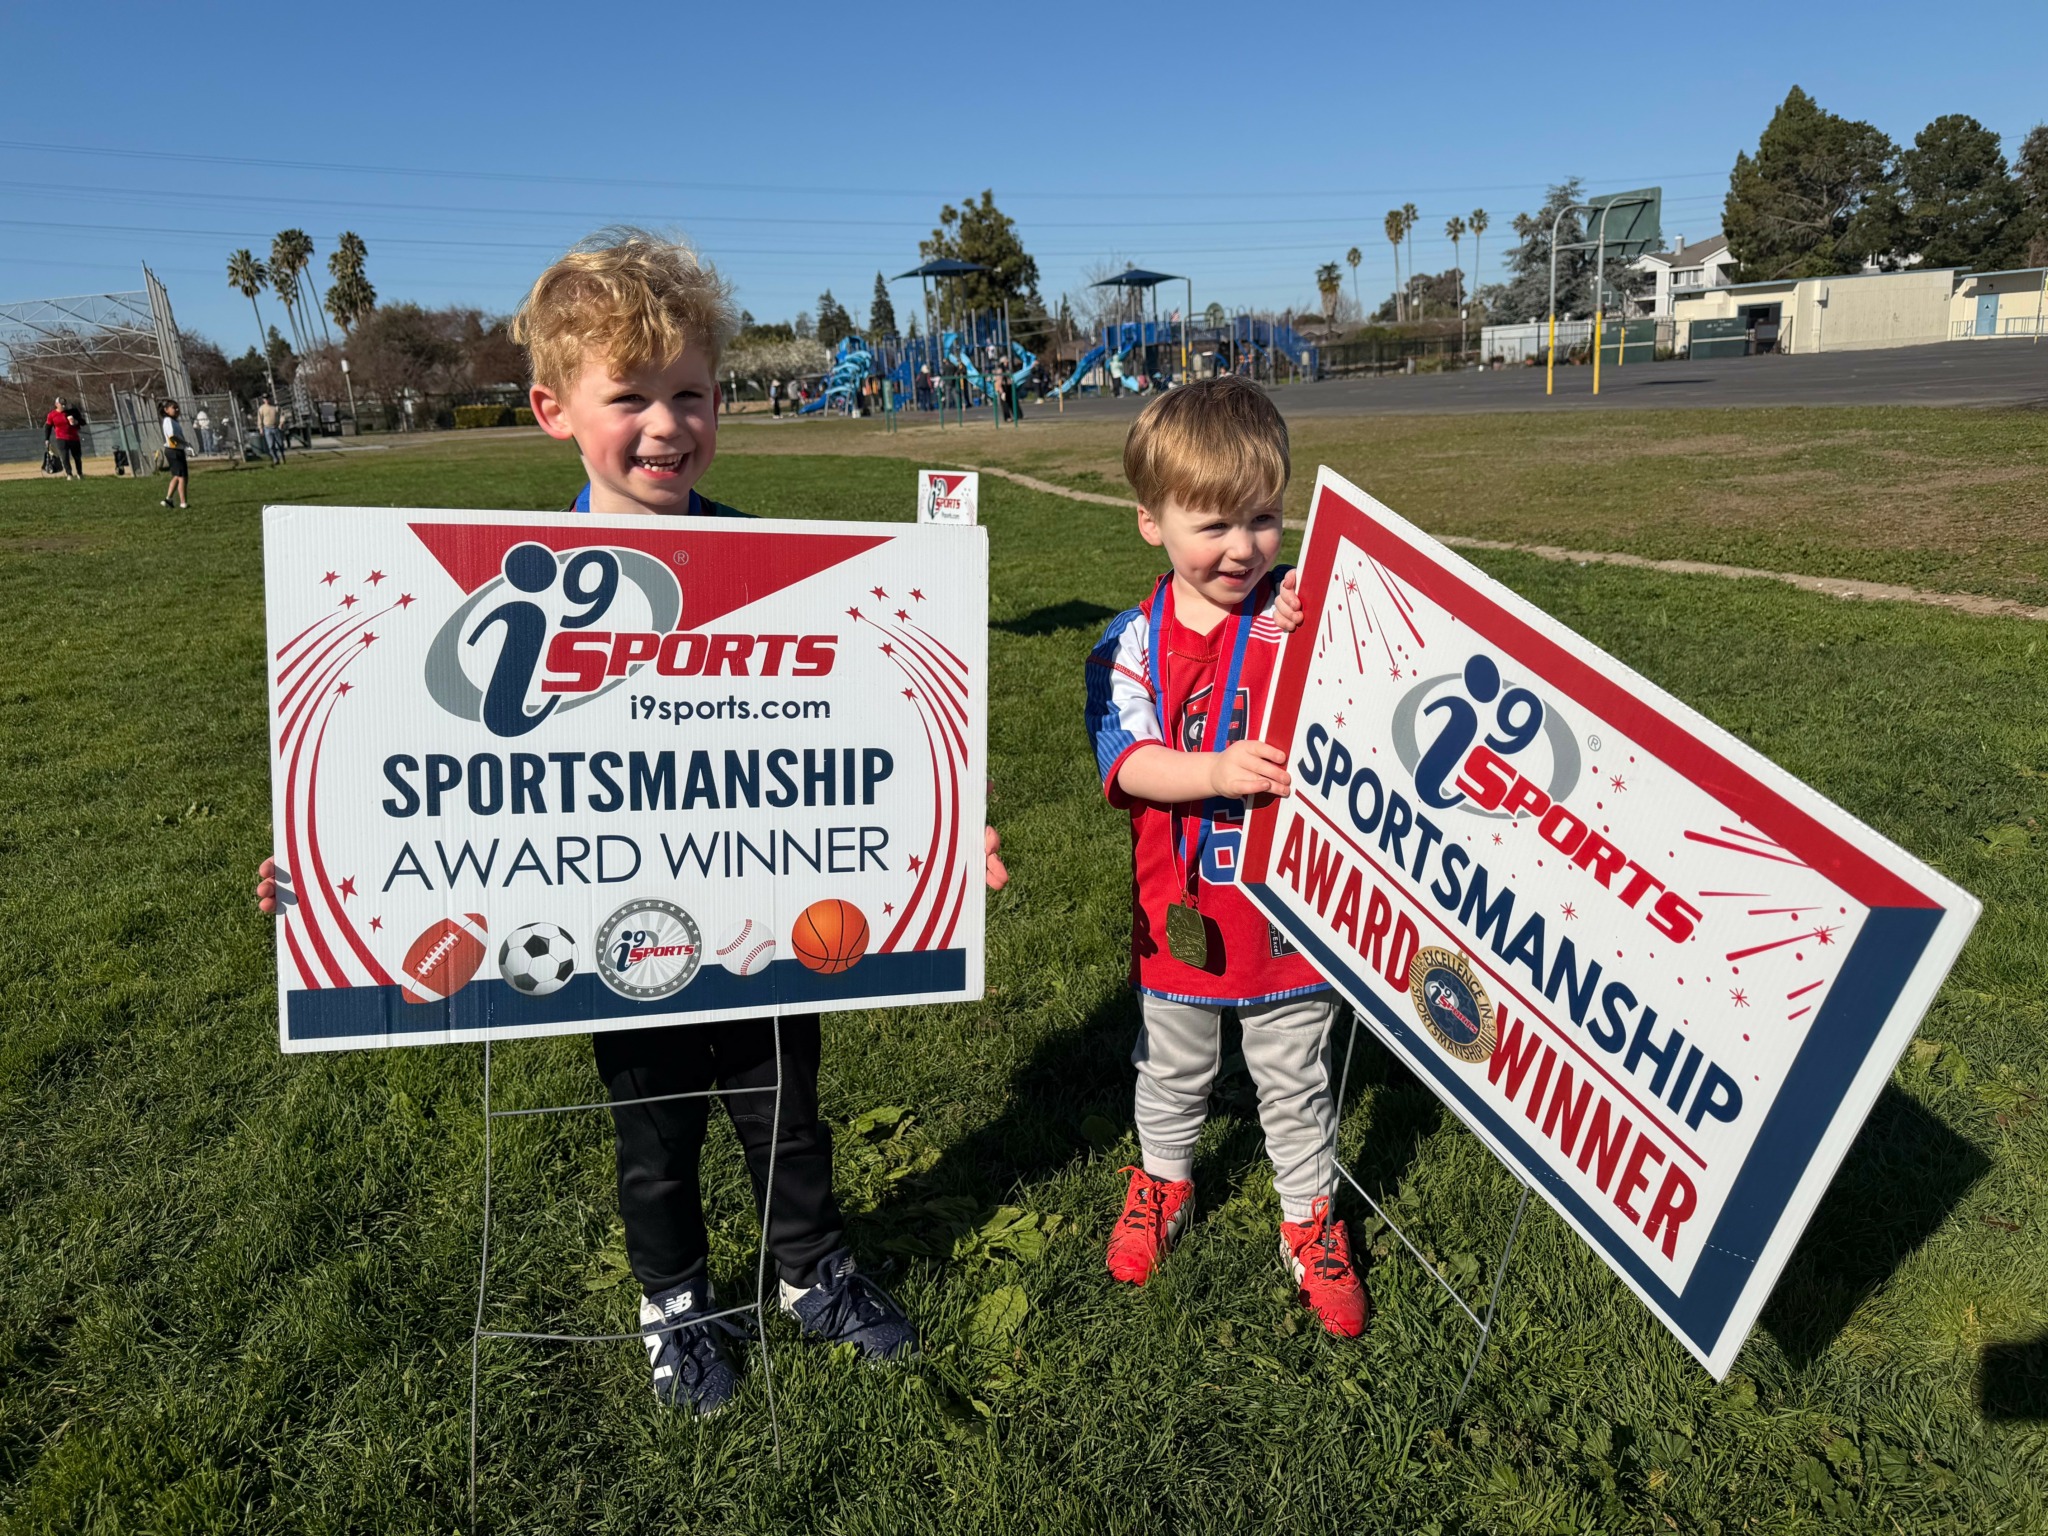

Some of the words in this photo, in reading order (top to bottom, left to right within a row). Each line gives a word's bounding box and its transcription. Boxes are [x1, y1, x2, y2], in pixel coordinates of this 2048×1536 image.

[467, 544, 619, 738] i9
[541, 631, 838, 693] SPORTS
[630, 694, 831, 725] i9sports.com
[1414, 654, 1544, 809] i9
[382, 748, 894, 818] SPORTSMANSHIP
[382, 834, 640, 892] AWARD
[660, 826, 889, 880] WINNER
[1455, 745, 1704, 944] SPORTS
[613, 930, 646, 972] i9
[628, 945, 695, 962] SPORTS
[1298, 722, 1743, 1132] SPORTSMANSHIP
[1422, 950, 1485, 999] EXCELLENCE
[1480, 1003, 1493, 1019] IN
[1438, 995, 1479, 1035] SPORTS
[1276, 813, 1420, 993] AWARD
[1488, 1001, 1699, 1261] WINNER
[1412, 985, 1484, 1059] SPORTSMANSHIP
